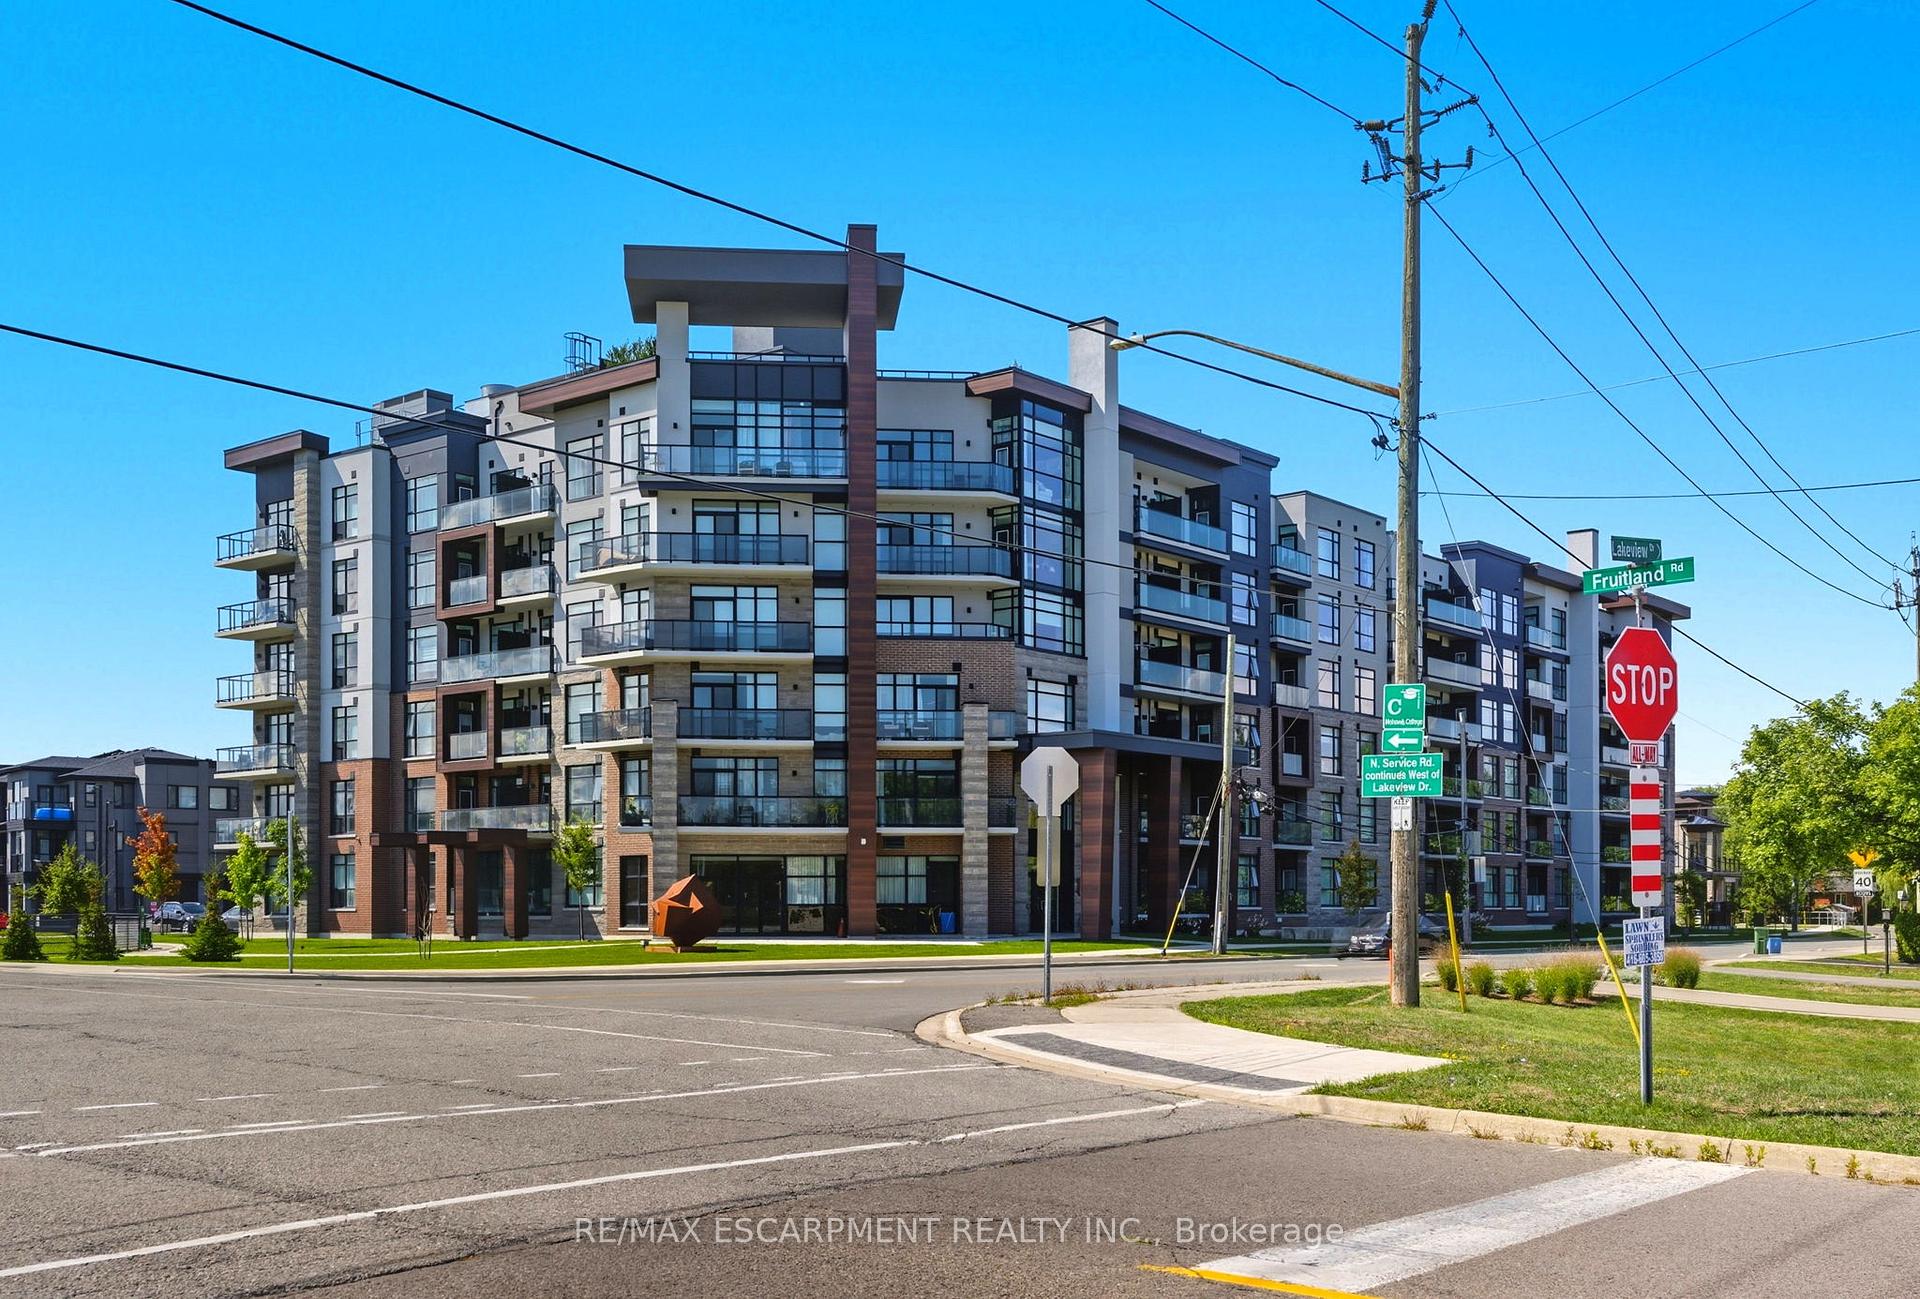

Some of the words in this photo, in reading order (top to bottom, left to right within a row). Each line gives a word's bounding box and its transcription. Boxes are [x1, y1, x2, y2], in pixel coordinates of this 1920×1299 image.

[1612, 541, 1648, 558] Lakeview
[1592, 565, 1664, 590] Fruitland
[1671, 562, 1684, 573] Rd
[1612, 663, 1674, 706] STOP
[1387, 698, 1402, 715] C
[1370, 758, 1380, 769] N.
[1383, 757, 1417, 768] Service
[1419, 756, 1435, 767] Rd.
[1365, 770, 1406, 780] continues
[1408, 769, 1429, 780] West
[1431, 768, 1440, 779] of
[1372, 782, 1415, 792] Lakeview
[1418, 781, 1431, 792] Dr.
[1855, 877, 1871, 887] 40
[1625, 921, 1649, 933] LAWN
